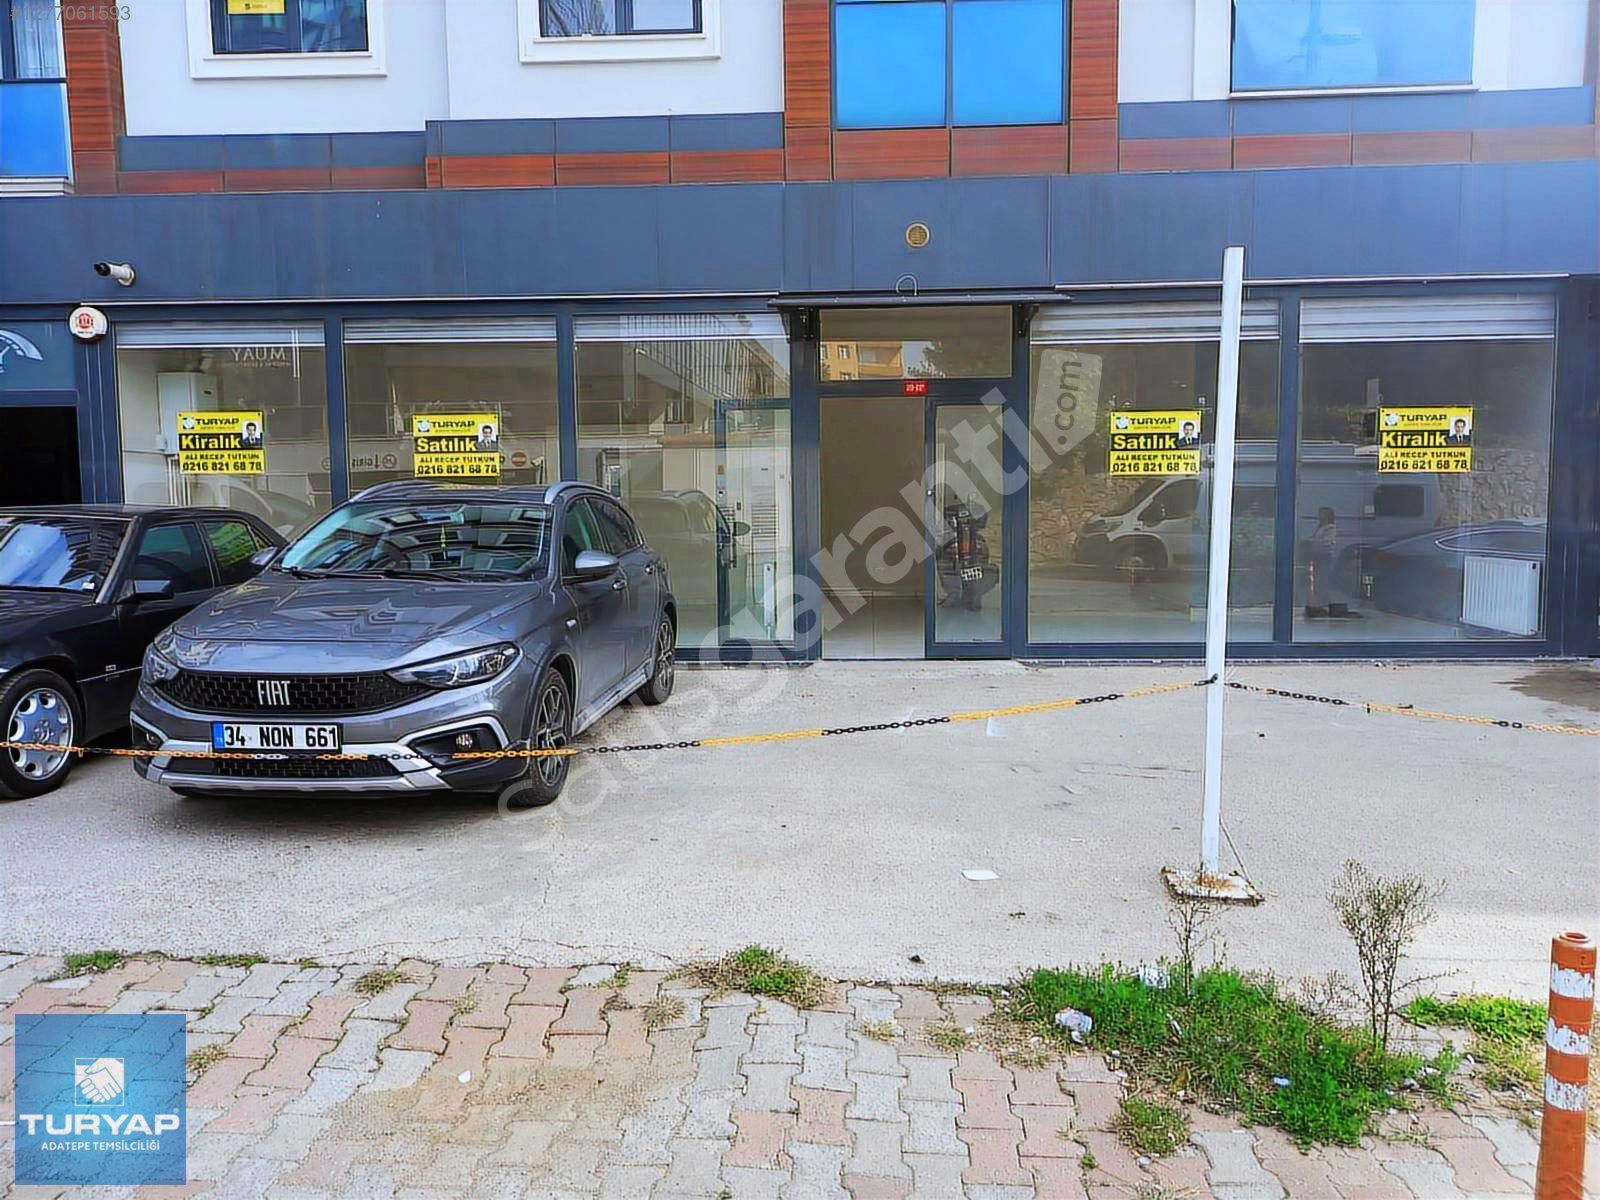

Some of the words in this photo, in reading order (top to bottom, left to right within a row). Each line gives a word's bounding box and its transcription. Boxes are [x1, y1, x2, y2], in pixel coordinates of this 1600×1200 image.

[195, 417, 239, 425] TURYAP
[1130, 417, 1176, 425] TURYAP
[1400, 414, 1447, 422] TURYAP
[181, 434, 240, 449] Kiralık
[1113, 435, 1176, 449] Satılık
[1382, 432, 1447, 447] Kiralık
[417, 438, 477, 452] Satılık
[183, 462, 208, 471] 0216
[212, 462, 229, 471] 821
[234, 462, 245, 471] 68
[248, 462, 261, 471] 78
[418, 465, 443, 474] 0216
[446, 465, 464, 474] 821
[469, 465, 481, 474] 68
[483, 465, 497, 474] 78
[1113, 463, 1139, 472] 0216
[1143, 463, 1162, 472] 821
[1167, 463, 1179, 472] 68
[1183, 463, 1196, 472] 78
[1381, 460, 1408, 470] 0216
[1412, 460, 1431, 470] 821
[1437, 460, 1449, 470] 68
[1454, 460, 1467, 470] 78
[257, 680, 291, 706] FIAT
[224, 726, 246, 746] 34
[259, 726, 294, 747] NON
[305, 727, 337, 747] 661
